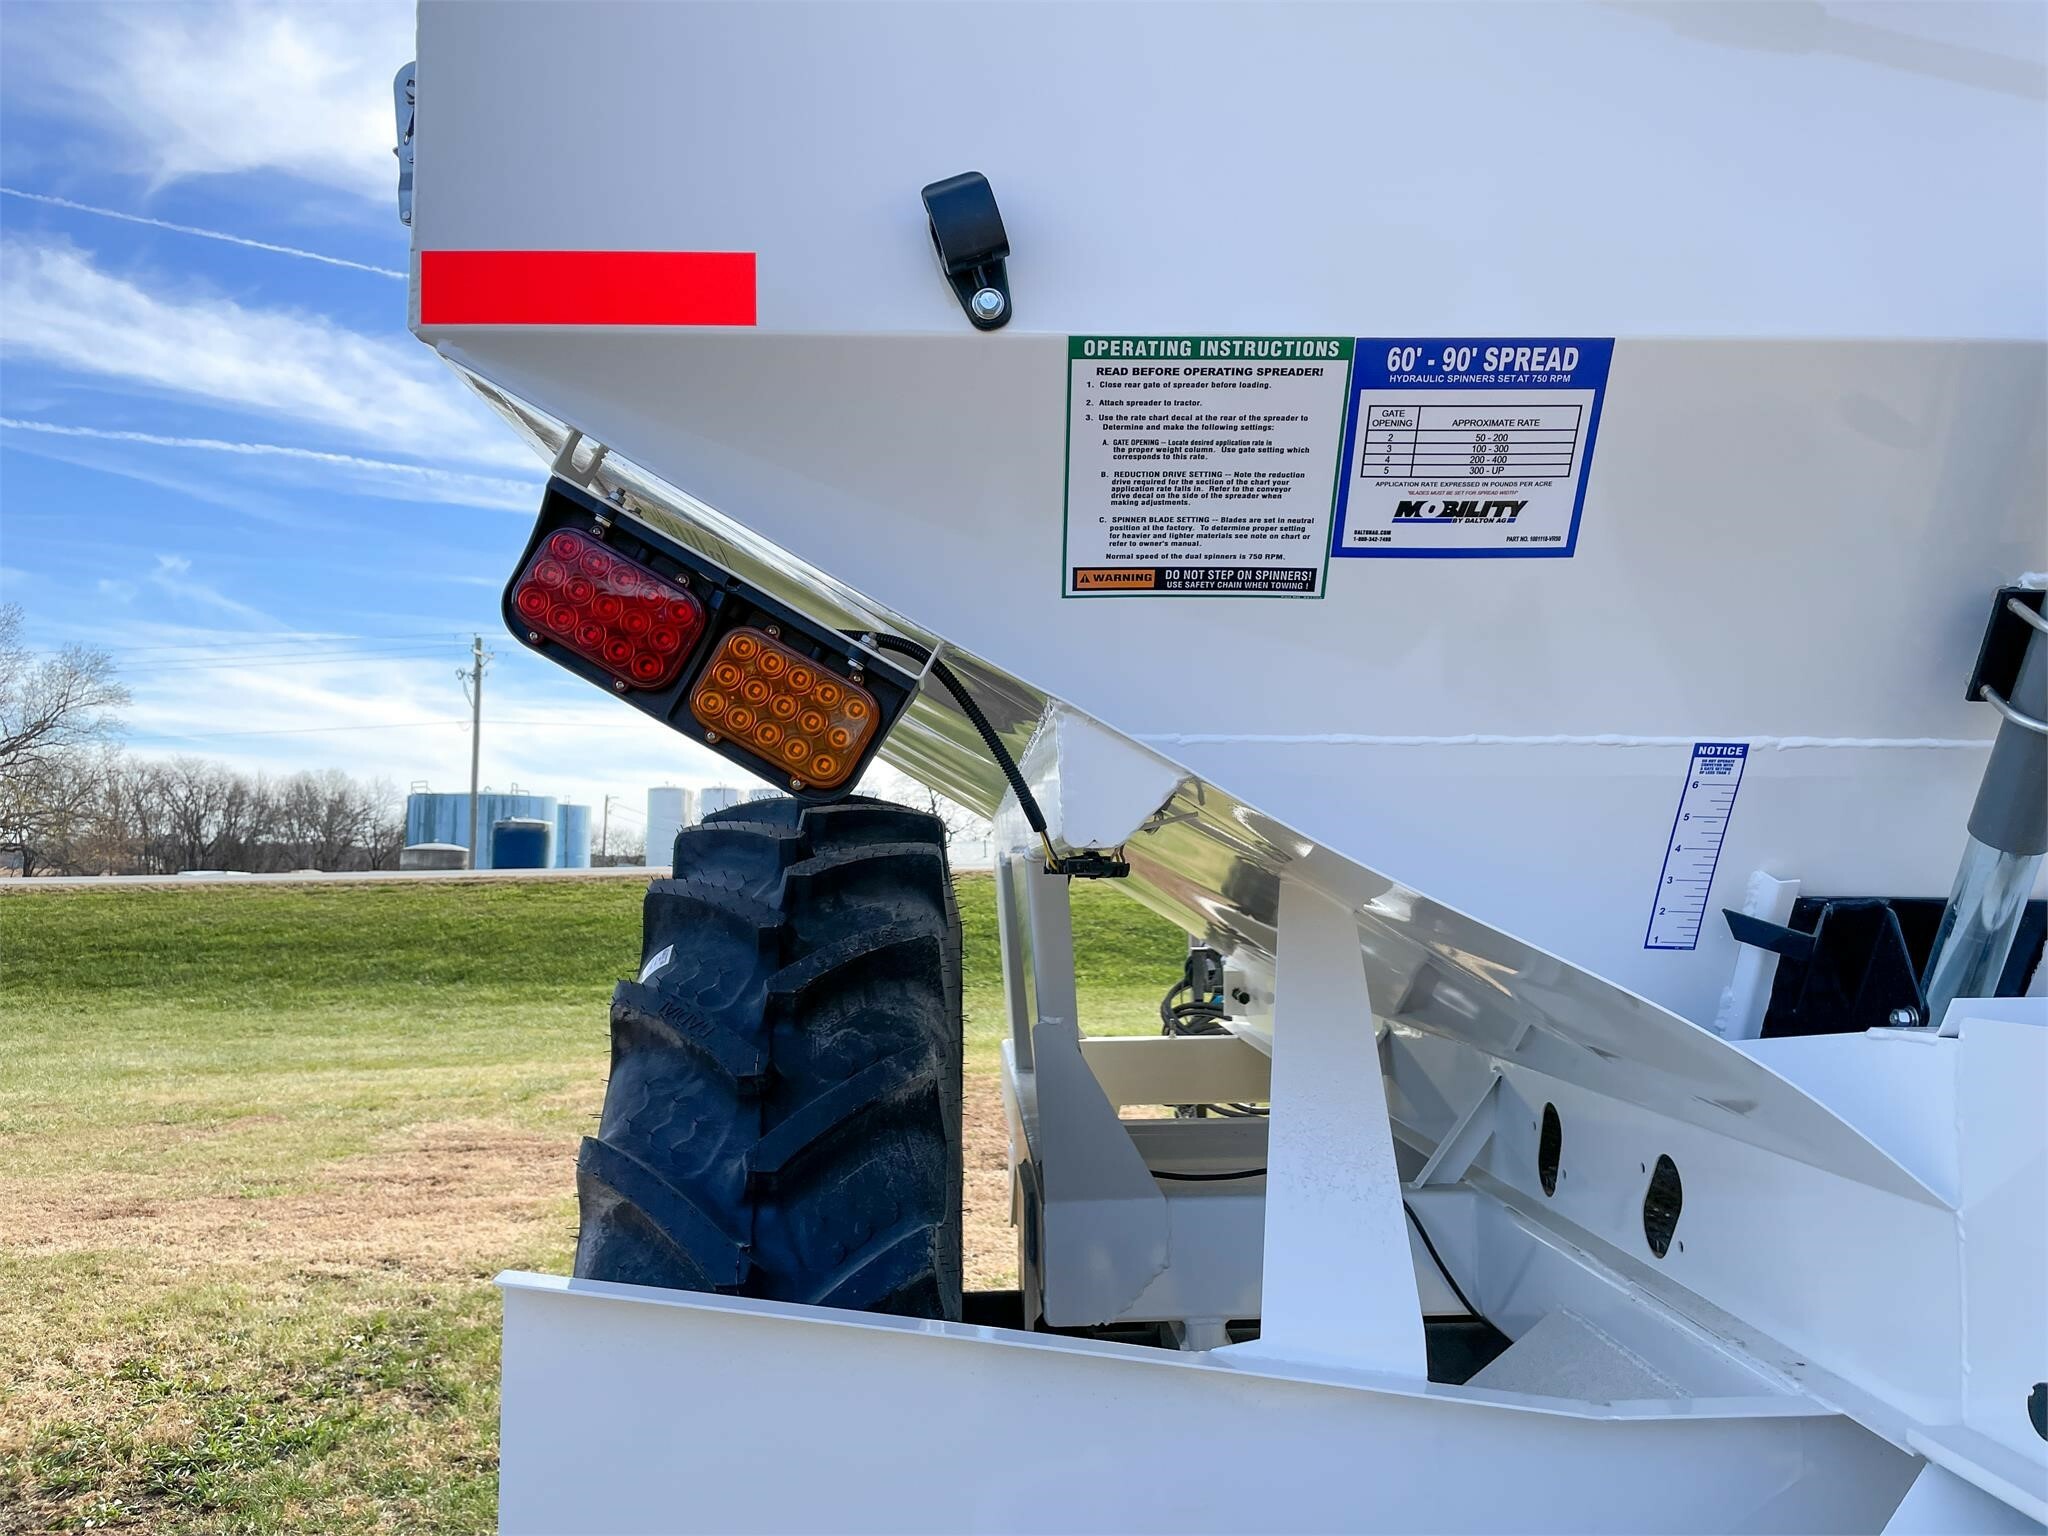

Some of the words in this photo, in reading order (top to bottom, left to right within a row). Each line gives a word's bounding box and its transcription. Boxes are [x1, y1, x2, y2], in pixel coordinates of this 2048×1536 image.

[1084, 340, 1191, 356] OPERATING
[1200, 340, 1340, 356] INSTRUCTIONS
[1387, 347, 1422, 371] 60'
[1442, 347, 1477, 371] 90'
[1483, 347, 1579, 371] SPREAD
[1183, 367, 1252, 375] OPERATING
[1394, 501, 1528, 517] MOBILITY
[1164, 570, 1180, 579] DO
[1183, 570, 1203, 579] NOT
[1207, 570, 1234, 579] STEP
[1237, 570, 1252, 579] ON
[1255, 571, 1313, 580] SPINNERS!
[1698, 746, 1744, 756] NOTICE
